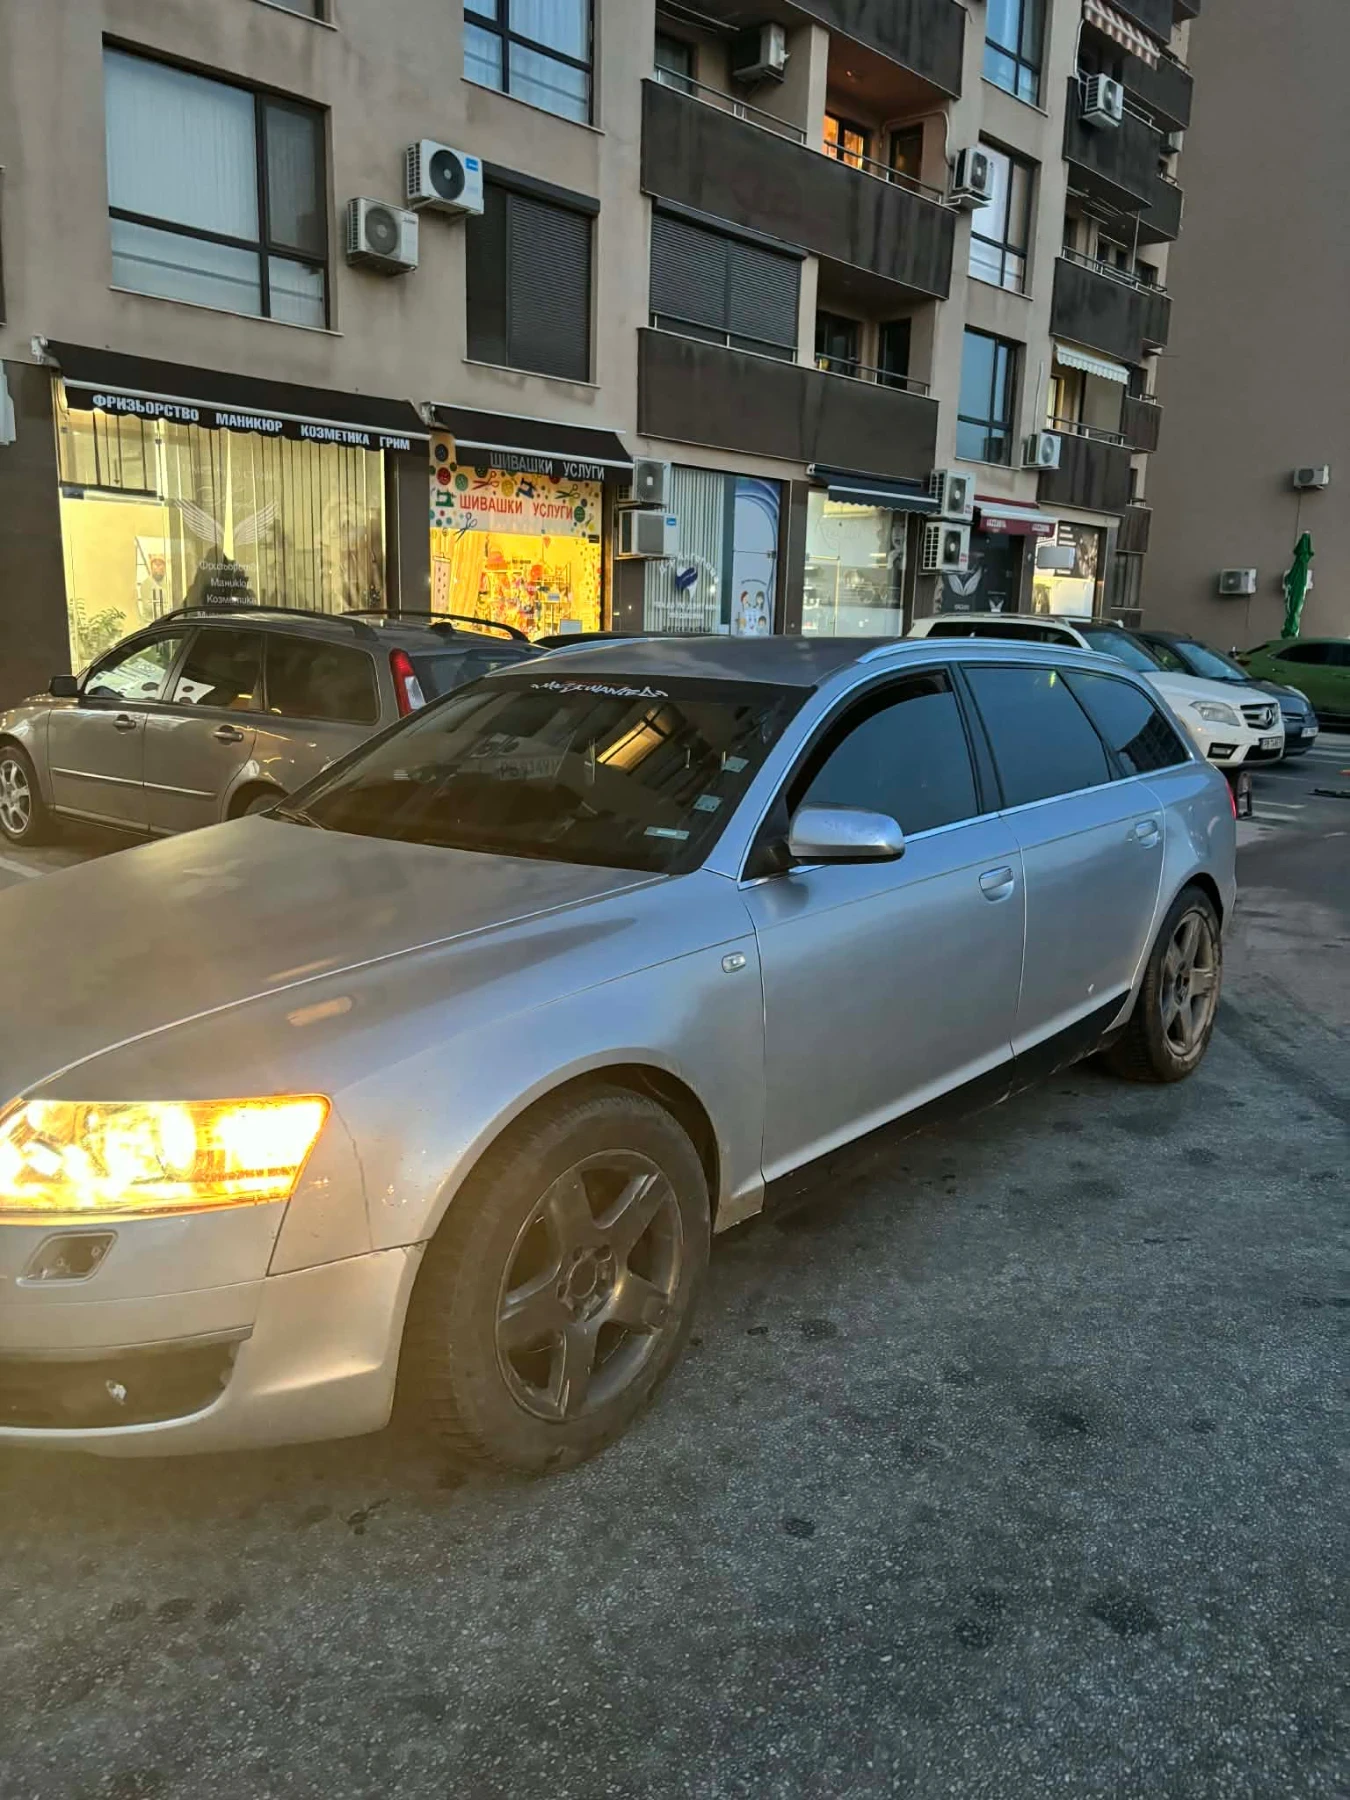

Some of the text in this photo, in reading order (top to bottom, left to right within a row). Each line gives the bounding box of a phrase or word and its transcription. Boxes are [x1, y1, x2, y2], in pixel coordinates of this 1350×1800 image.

[92, 394, 411, 451] ФРИЗЬОРСТВО МАНИКЮР КОЗМЕТИКА ГРИМ
[490, 452, 605, 481] ШИВАШКИ УСЛУГИ
[459, 494, 573, 521] ШИВАШКИ УСЛУГИ
